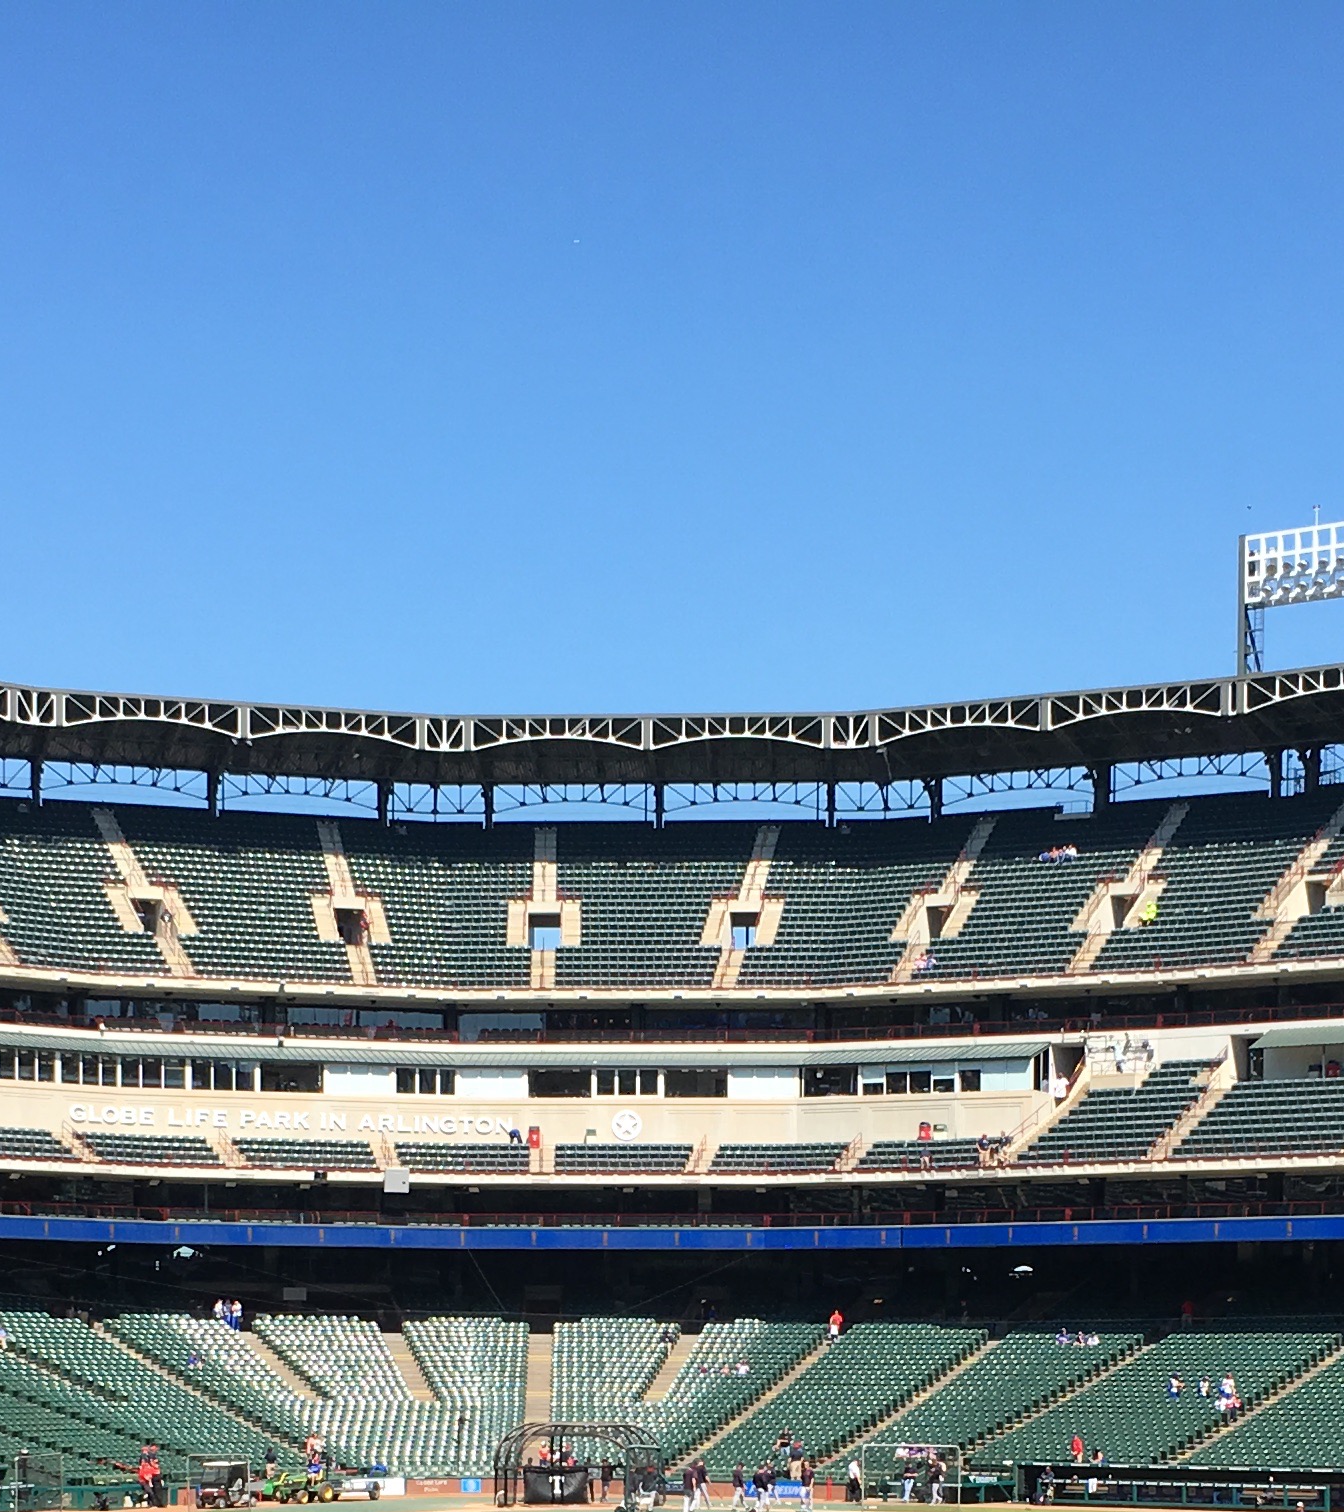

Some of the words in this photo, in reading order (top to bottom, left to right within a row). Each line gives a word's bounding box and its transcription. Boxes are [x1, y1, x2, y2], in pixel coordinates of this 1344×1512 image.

[69, 1104, 155, 1126] GLOBE
[167, 1108, 228, 1129] LIFE
[240, 1110, 310, 1131] PARK
[320, 1112, 347, 1131] IN
[357, 1113, 514, 1136] ARLINGTON
